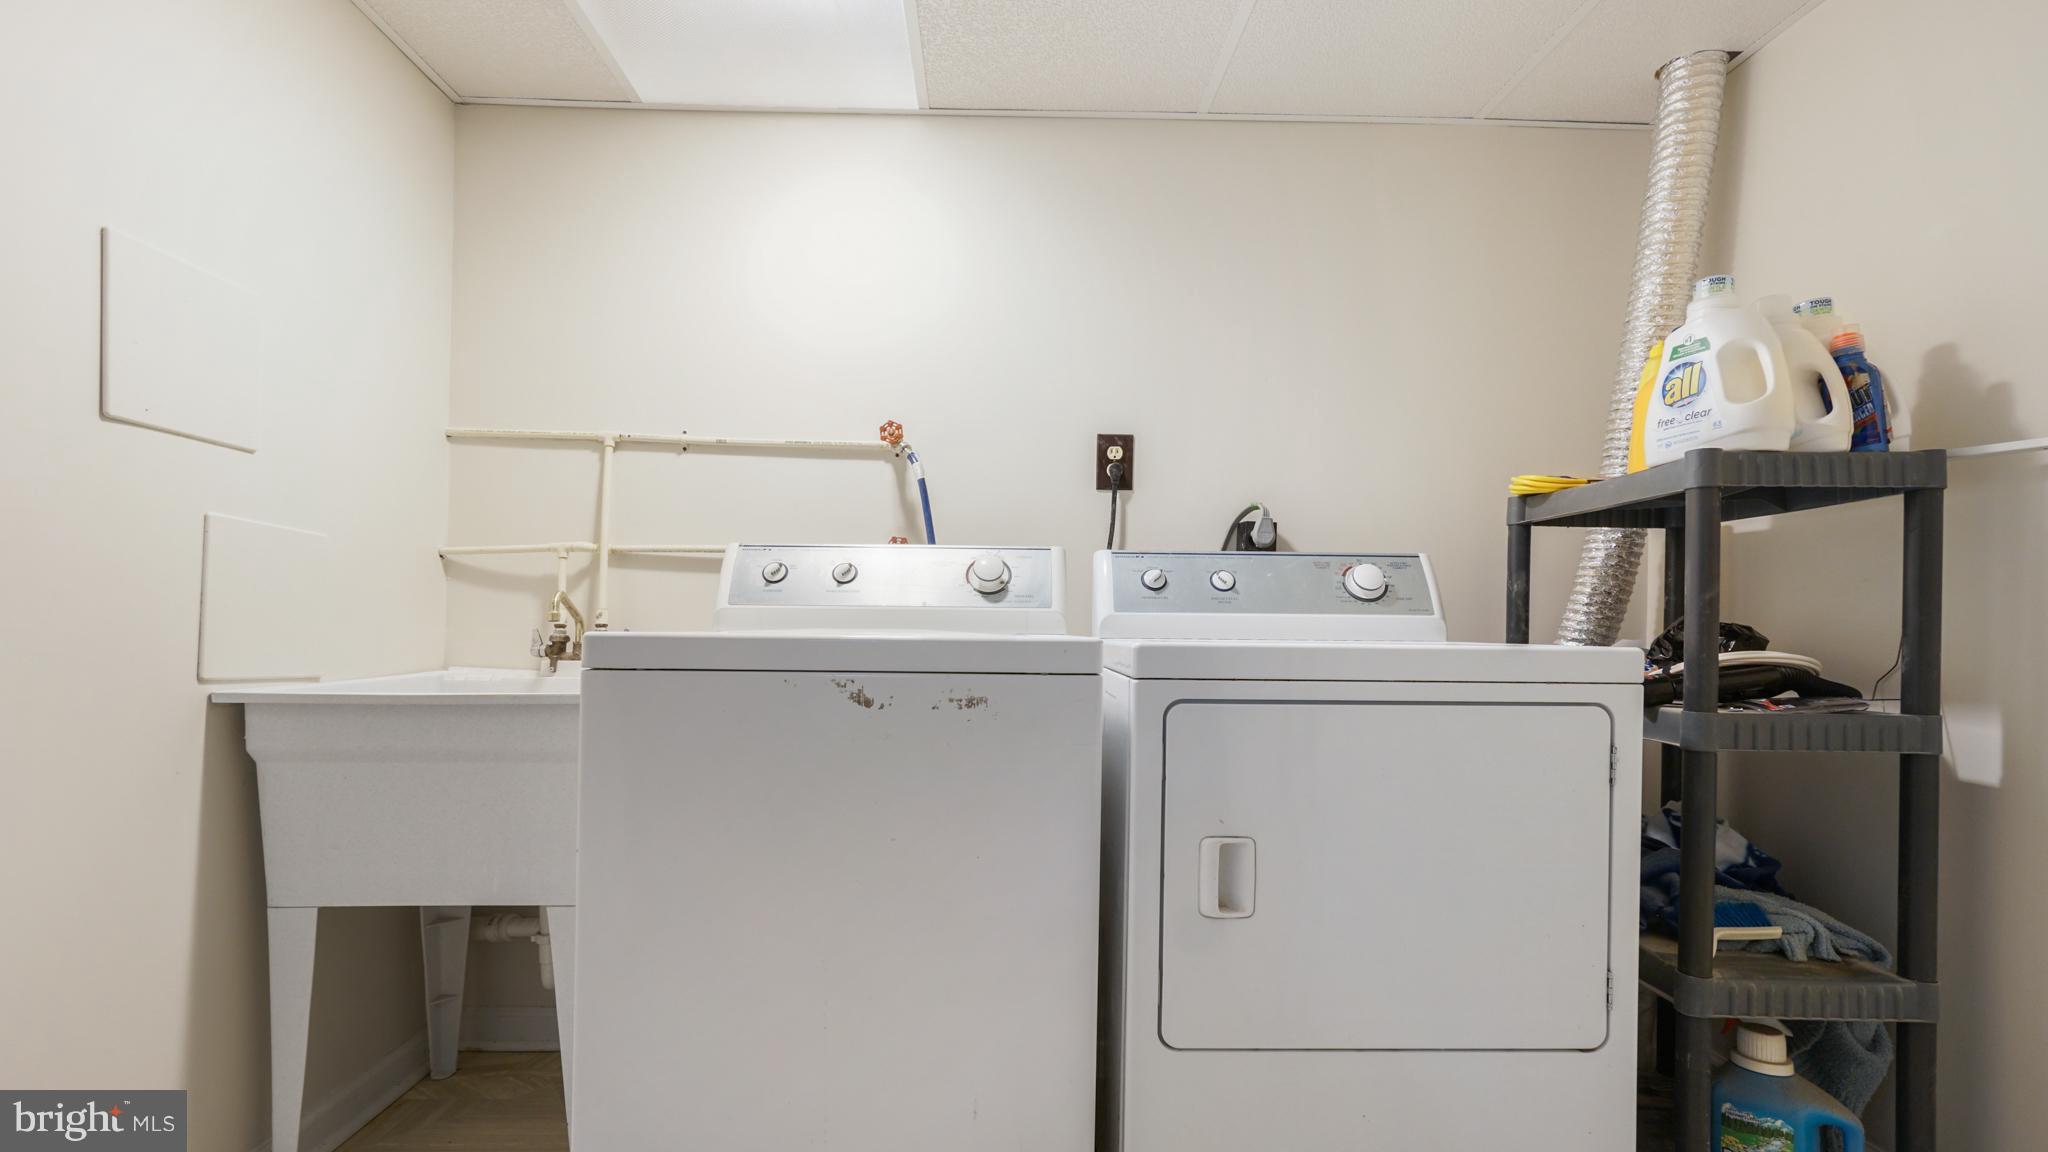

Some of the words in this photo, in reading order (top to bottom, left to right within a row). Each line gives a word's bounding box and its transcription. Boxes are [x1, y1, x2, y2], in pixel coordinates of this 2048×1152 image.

[1664, 361, 1703, 407] all
[1657, 417, 1676, 429] free
[1685, 408, 1712, 421] clear
